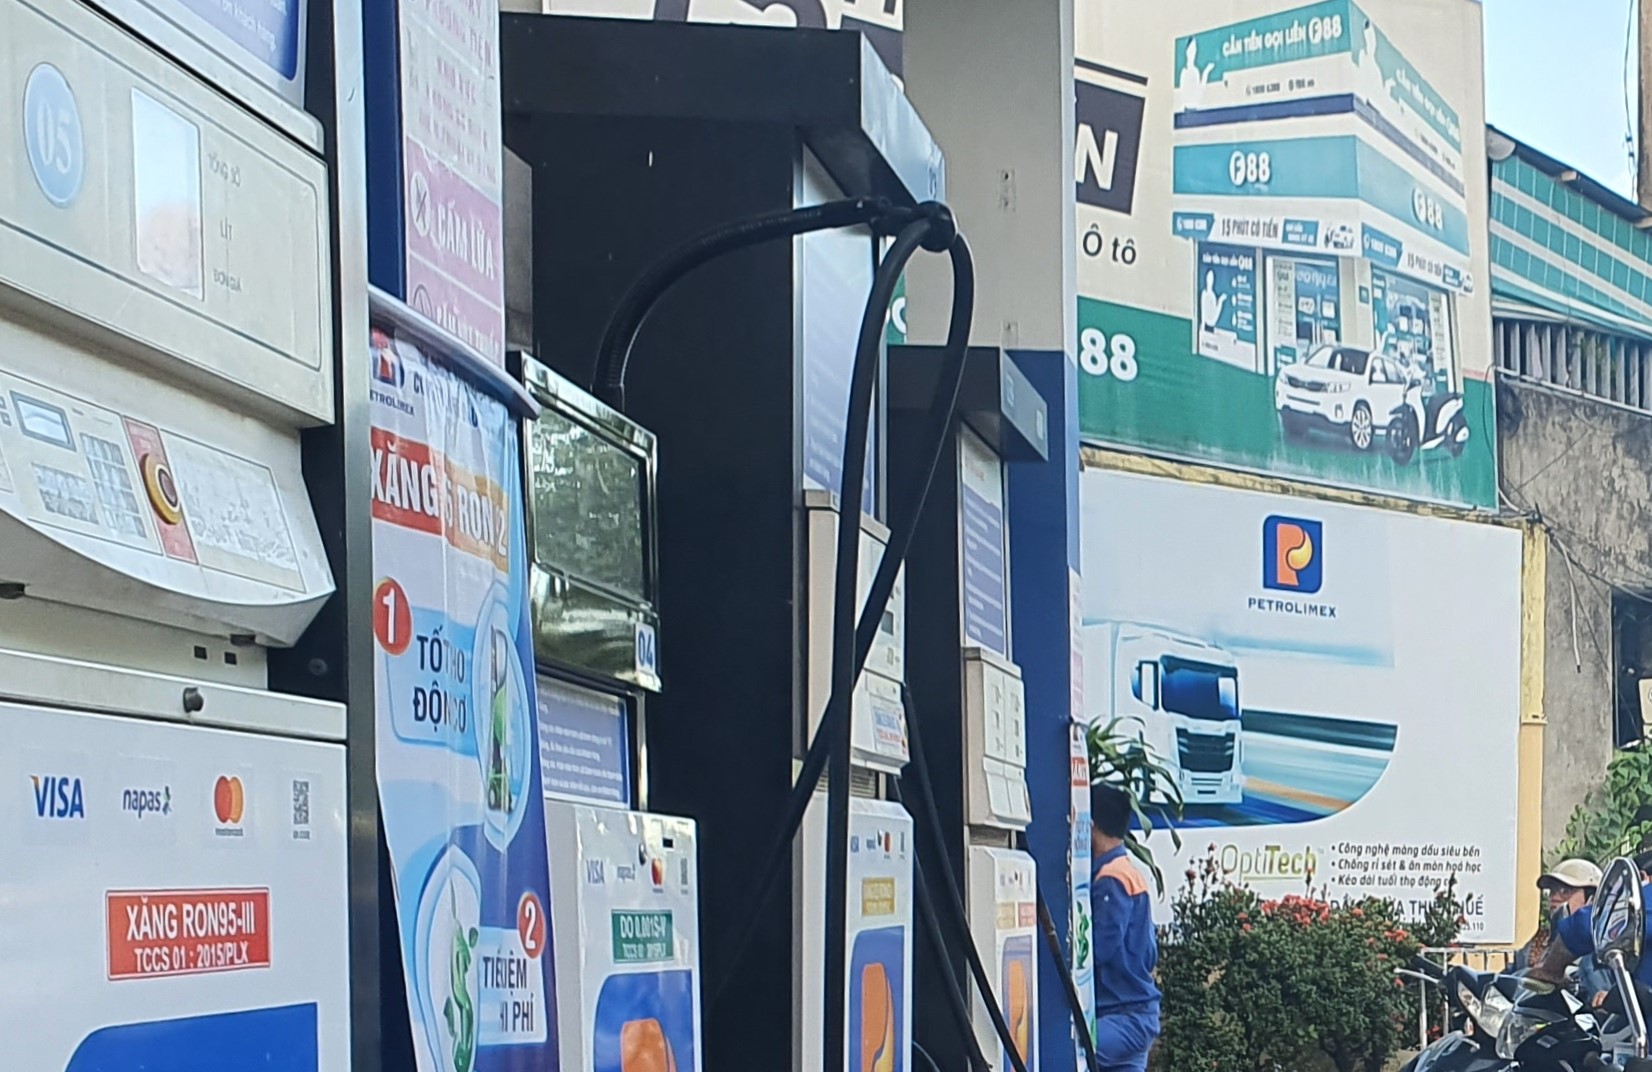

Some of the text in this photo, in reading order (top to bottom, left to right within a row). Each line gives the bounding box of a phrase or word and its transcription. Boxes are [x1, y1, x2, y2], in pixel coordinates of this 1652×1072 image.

[1309, 14, 1343, 45] F88
[36, 101, 73, 175] 05
[1229, 150, 1272, 187] F88
[1083, 222, 1137, 265] Ô tô
[370, 391, 415, 417] ETROLIMEX
[382, 587, 396, 645] 1
[1247, 596, 1338, 619] PETROLIMEX
[638, 630, 654, 668] 04
[30, 775, 85, 819] VISA
[122, 787, 162, 819] napas
[1221, 844, 1317, 886] OptiTech
[1338, 843, 1363, 857] Công
[1365, 843, 1390, 858] nghệ
[1441, 844, 1461, 857] siêu
[1381, 860, 1397, 871] sét
[1399, 859, 1406, 871] &
[1338, 874, 1357, 886] Kéo
[126, 896, 256, 941] XĂNG RON95-III
[525, 900, 537, 950] 2
[135, 947, 169, 973] TCCS
[173, 945, 187, 969] 01
[197, 941, 250, 969] 2015/PLX
[512, 992, 535, 1032] PHÍ
